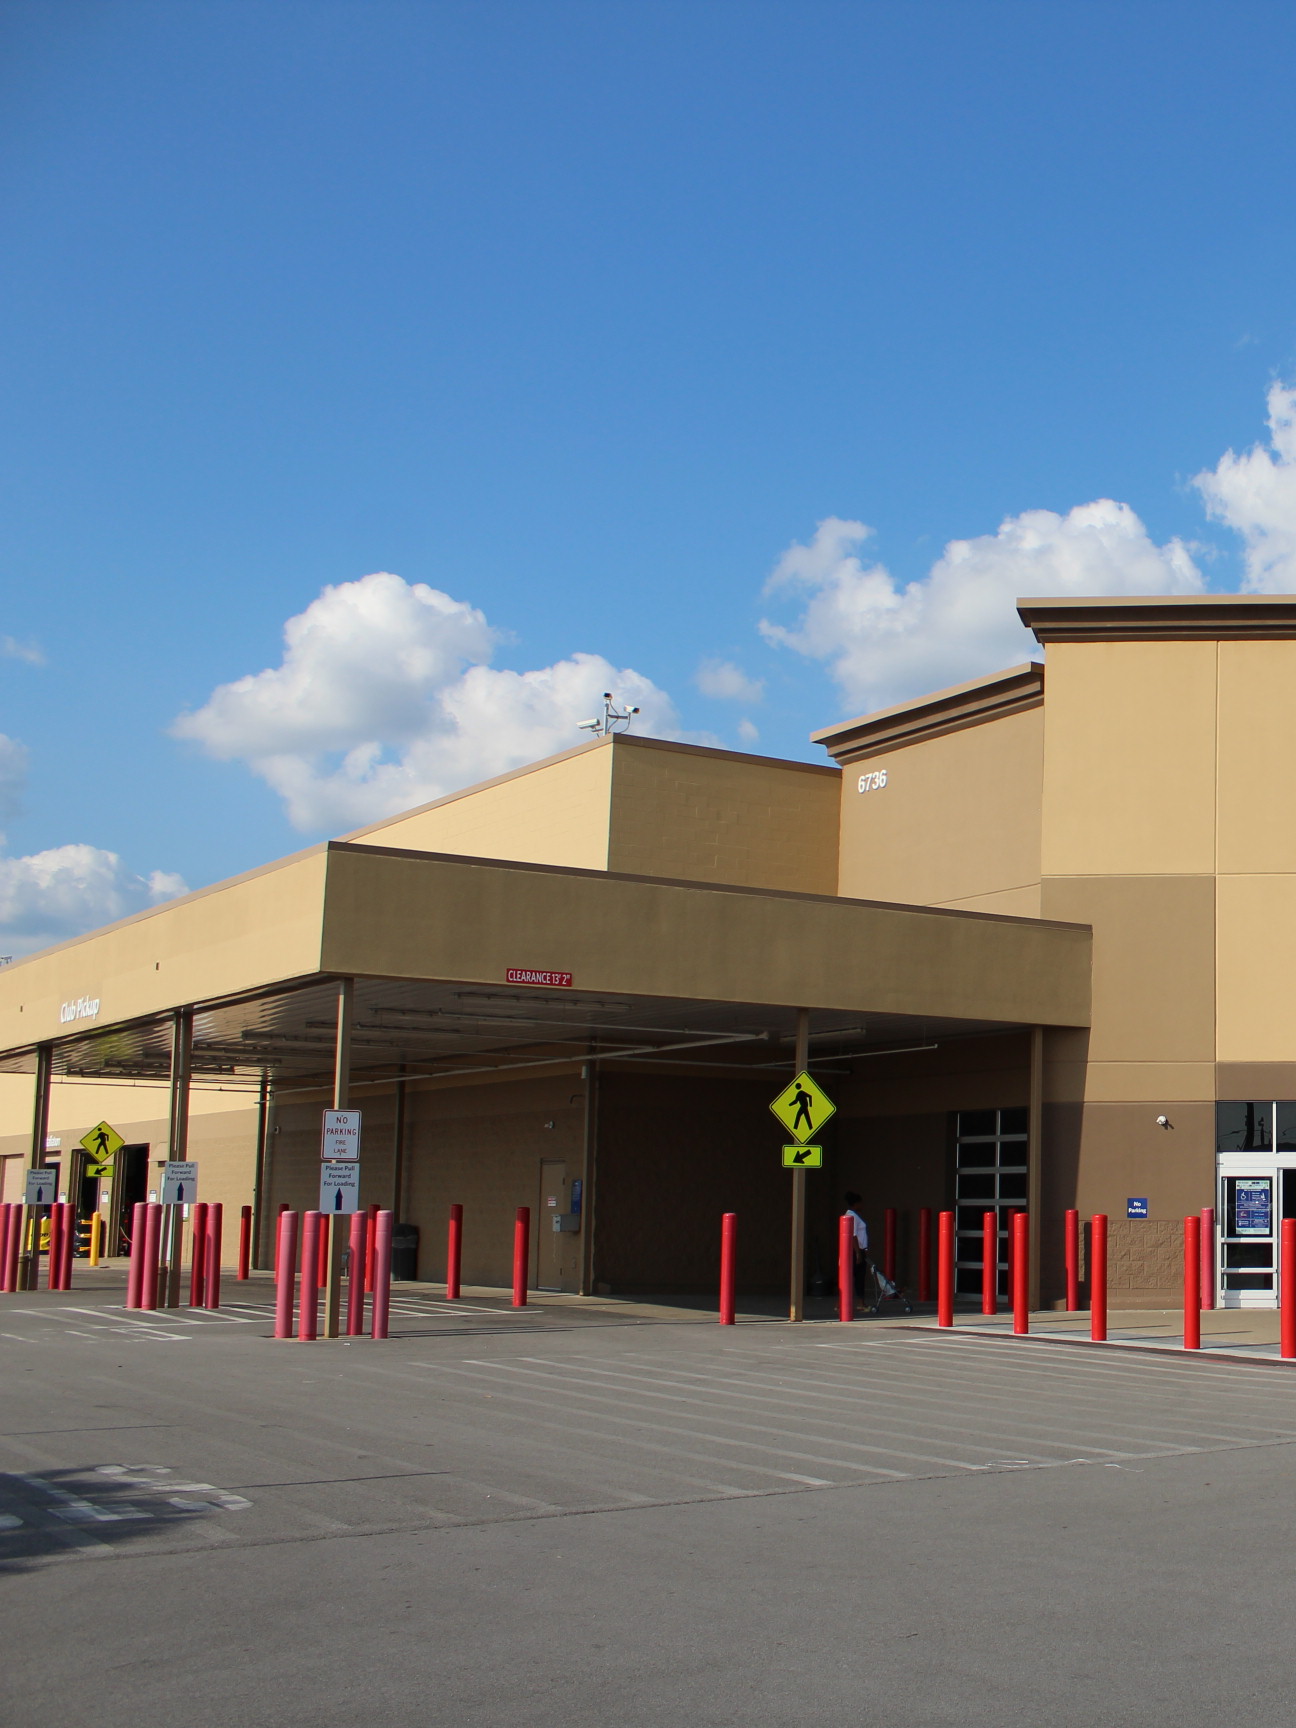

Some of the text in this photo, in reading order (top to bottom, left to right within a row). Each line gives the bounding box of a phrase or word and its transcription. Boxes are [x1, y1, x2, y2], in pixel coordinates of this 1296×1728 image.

[858, 770, 887, 793] 6736
[508, 970, 550, 983] CLEARANCE
[61, 995, 100, 1023] Club Pickup
[336, 1116, 348, 1124] NO
[326, 1128, 356, 1136] PARKING
